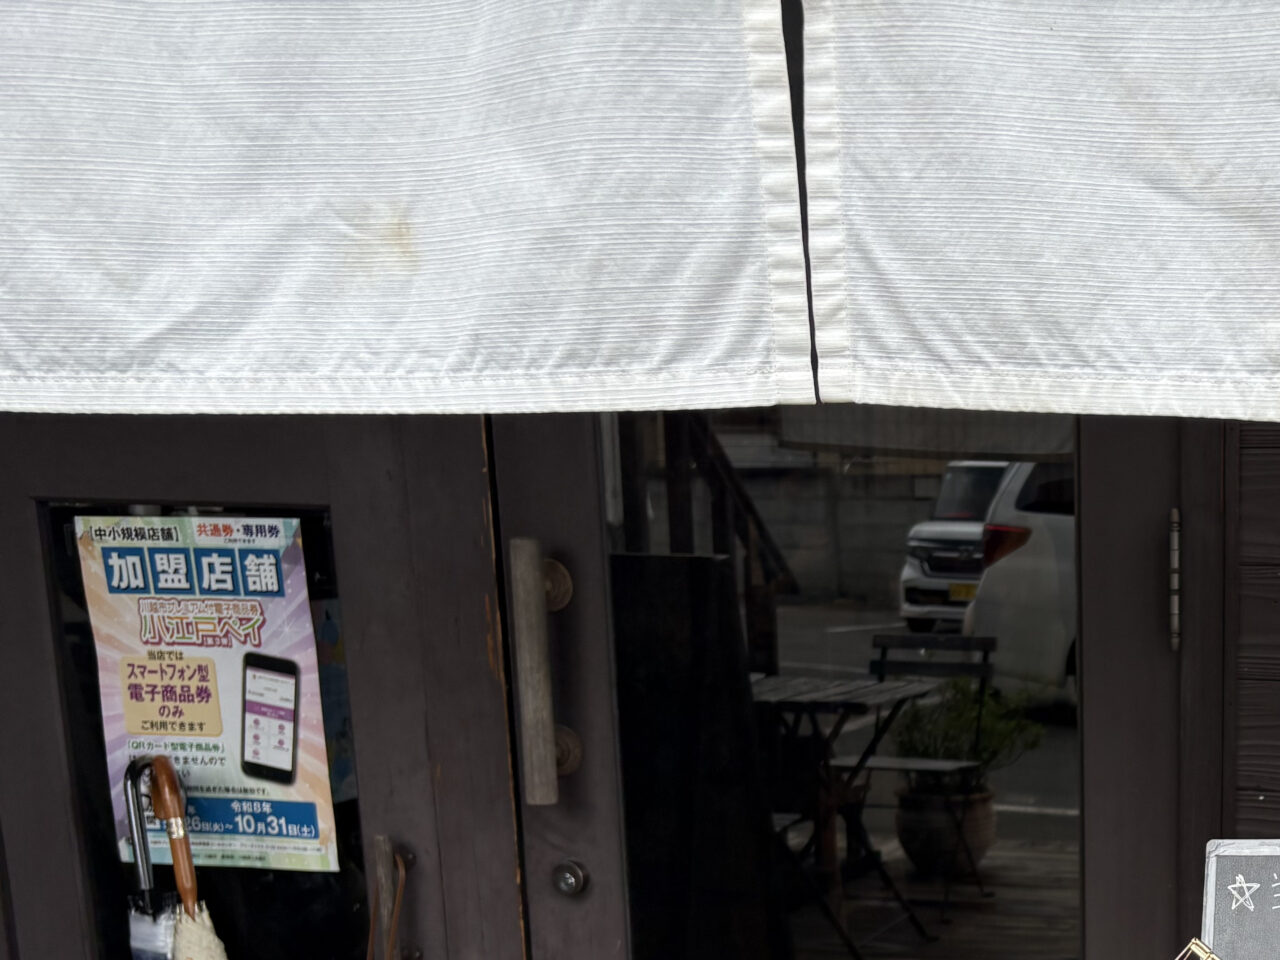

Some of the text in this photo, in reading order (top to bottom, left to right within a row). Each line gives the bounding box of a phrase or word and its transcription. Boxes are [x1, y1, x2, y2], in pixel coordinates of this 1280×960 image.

[108, 551, 279, 593] 加盟店舗
[141, 613, 263, 647] 小江戸ペイ
[147, 650, 184, 661] 当店では
[127, 663, 210, 683] スマートフォン型
[127, 684, 212, 704] 電子商品券
[158, 705, 184, 718] のみ
[140, 720, 206, 732] ご利用できます
